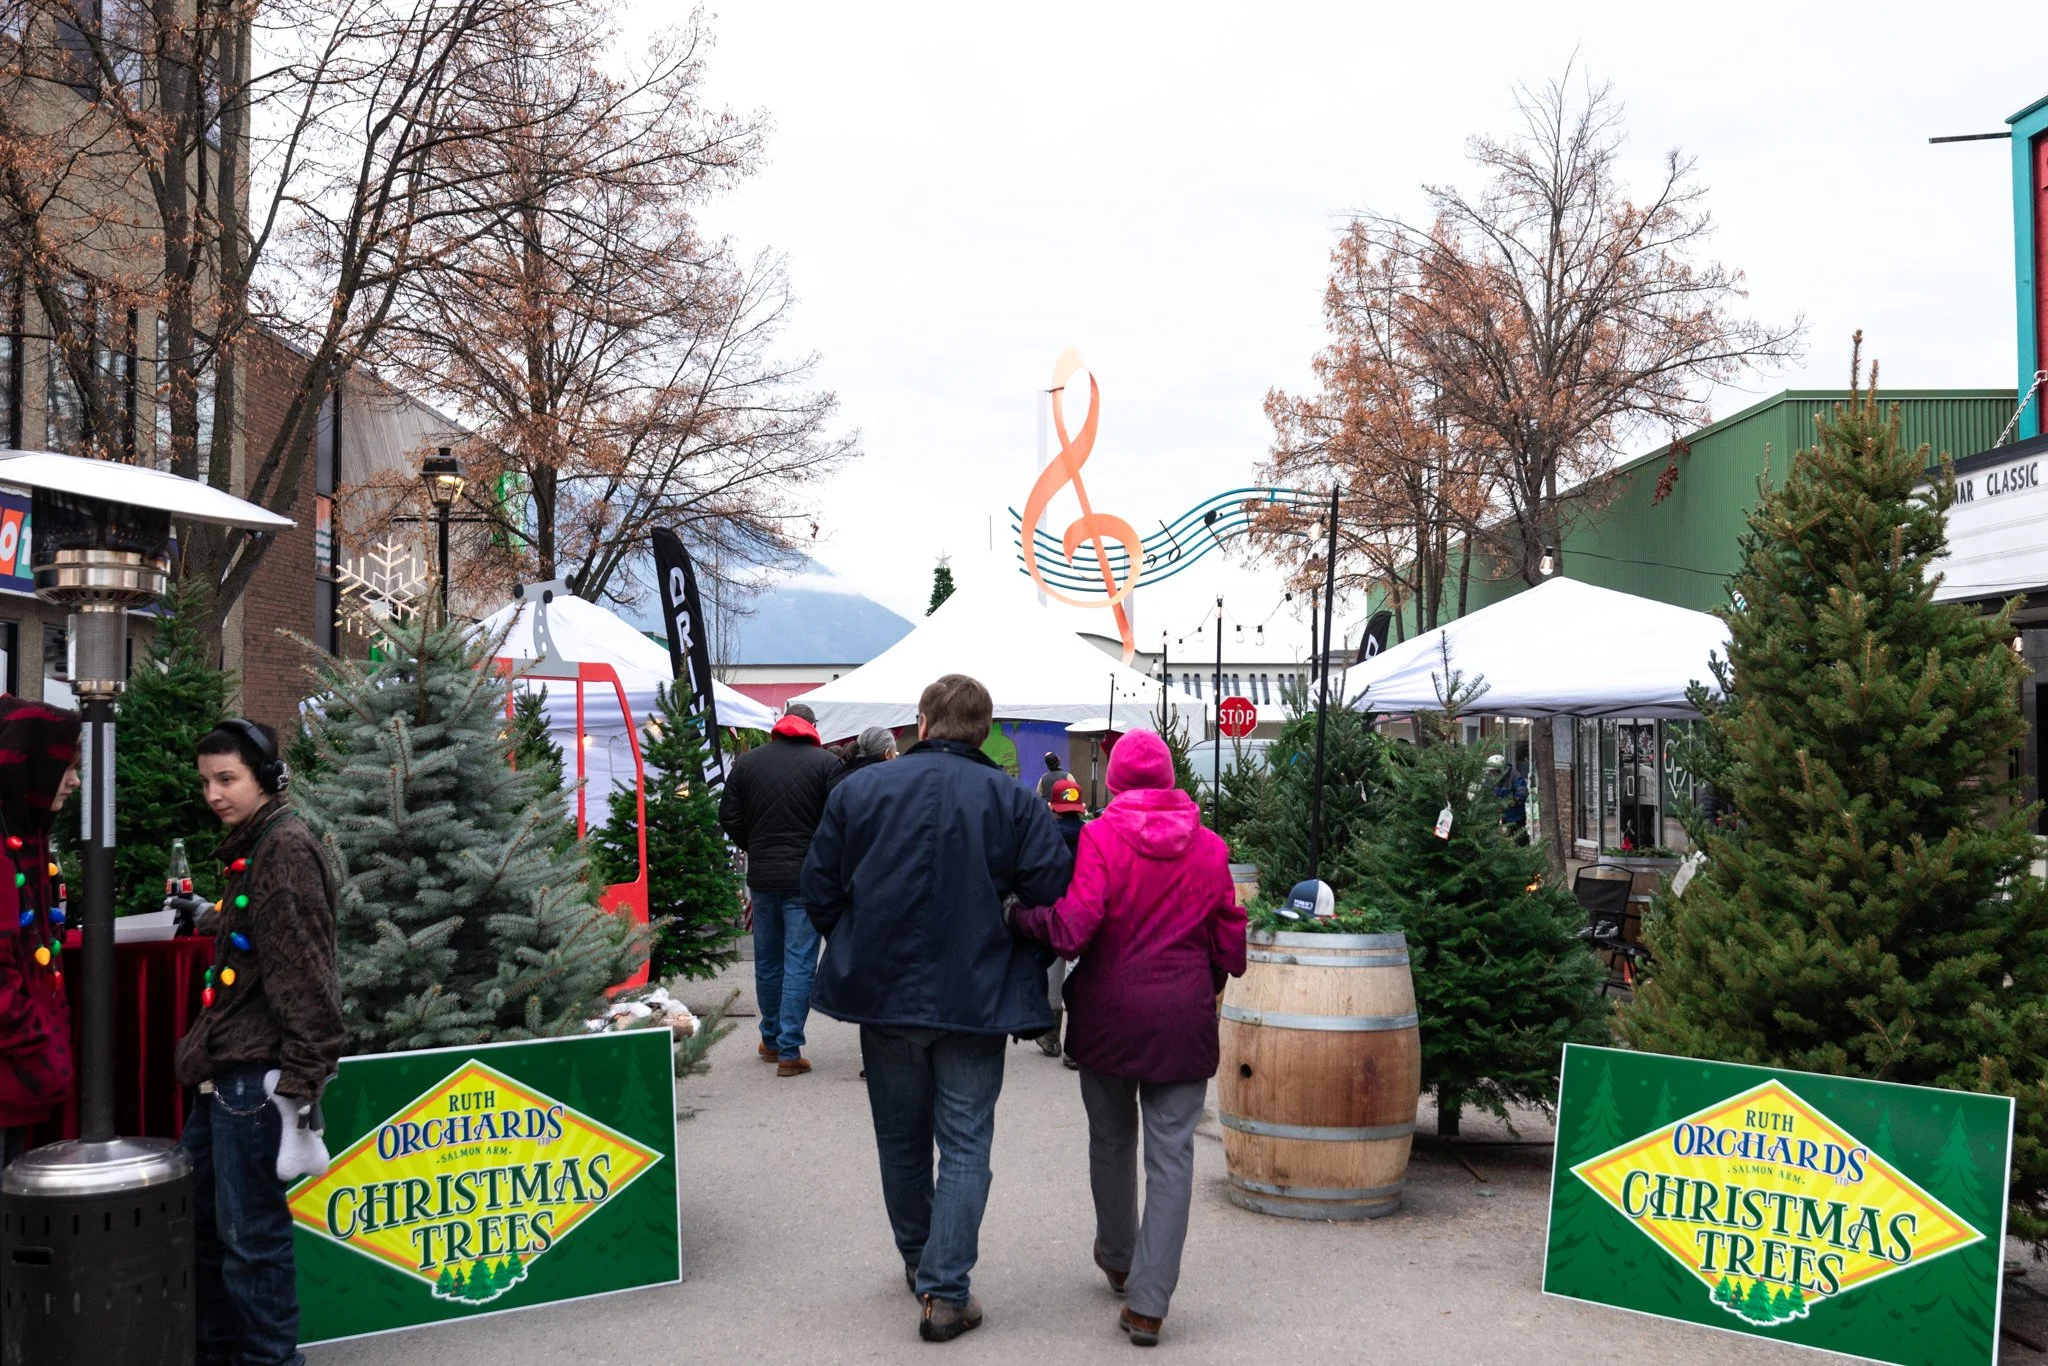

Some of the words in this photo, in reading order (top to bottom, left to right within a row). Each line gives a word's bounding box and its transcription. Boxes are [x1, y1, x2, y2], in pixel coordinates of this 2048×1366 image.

[1986, 462, 2039, 496] CLASSIC
[1220, 709, 1255, 725] STOP
[448, 1090, 496, 1113] RUTH
[1745, 1109, 1794, 1133] RUTH
[377, 1104, 565, 1161] ORCHARDS
[1672, 1122, 1869, 1183] ORCHARDS
[326, 1154, 612, 1240] CHRISTMAS
[1621, 1169, 1917, 1265] CHRISTMAS
[411, 1210, 555, 1271] TREES
[1695, 1228, 1845, 1297] TREES
